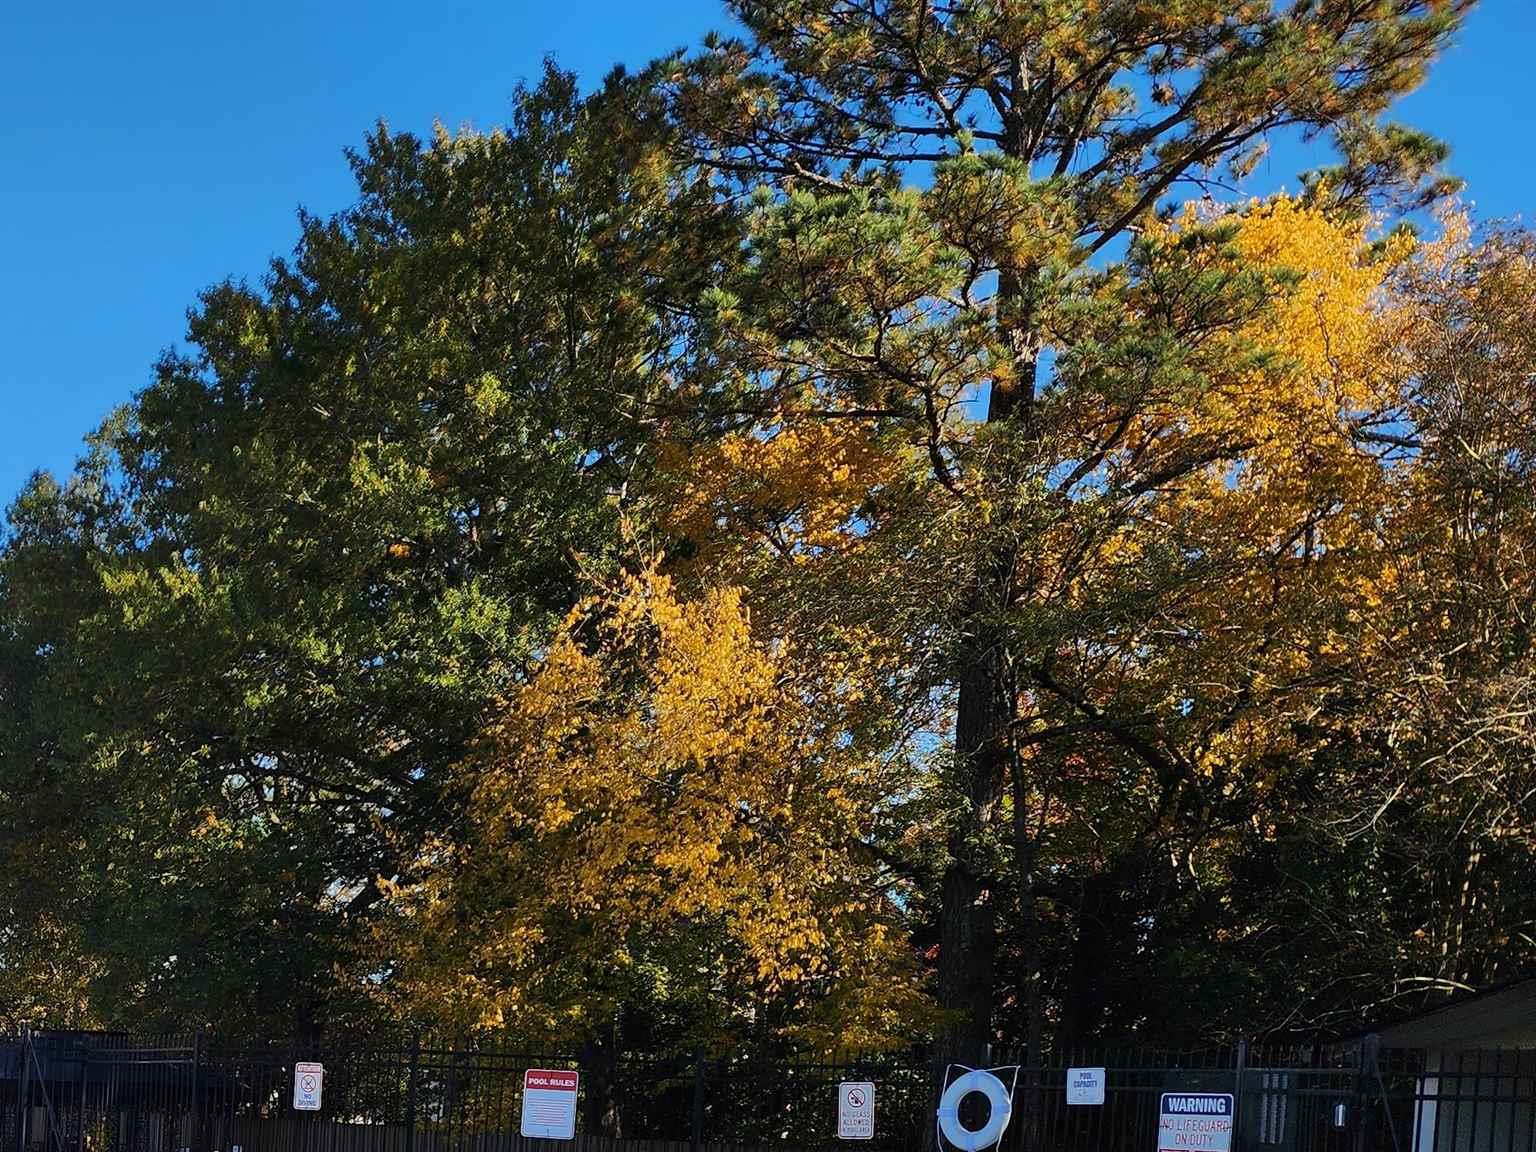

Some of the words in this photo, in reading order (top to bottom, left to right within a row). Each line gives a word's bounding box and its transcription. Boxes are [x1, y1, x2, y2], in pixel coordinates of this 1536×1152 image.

[528, 1077, 549, 1085] POOL
[549, 1079, 575, 1087] RULES
[1168, 1097, 1226, 1113] WARNING
[1161, 1119, 1174, 1129] NO
[1177, 1120, 1230, 1132] LIFEGUARD
[1176, 1133, 1188, 1145] ON
[1190, 1134, 1214, 1146] DUTY
